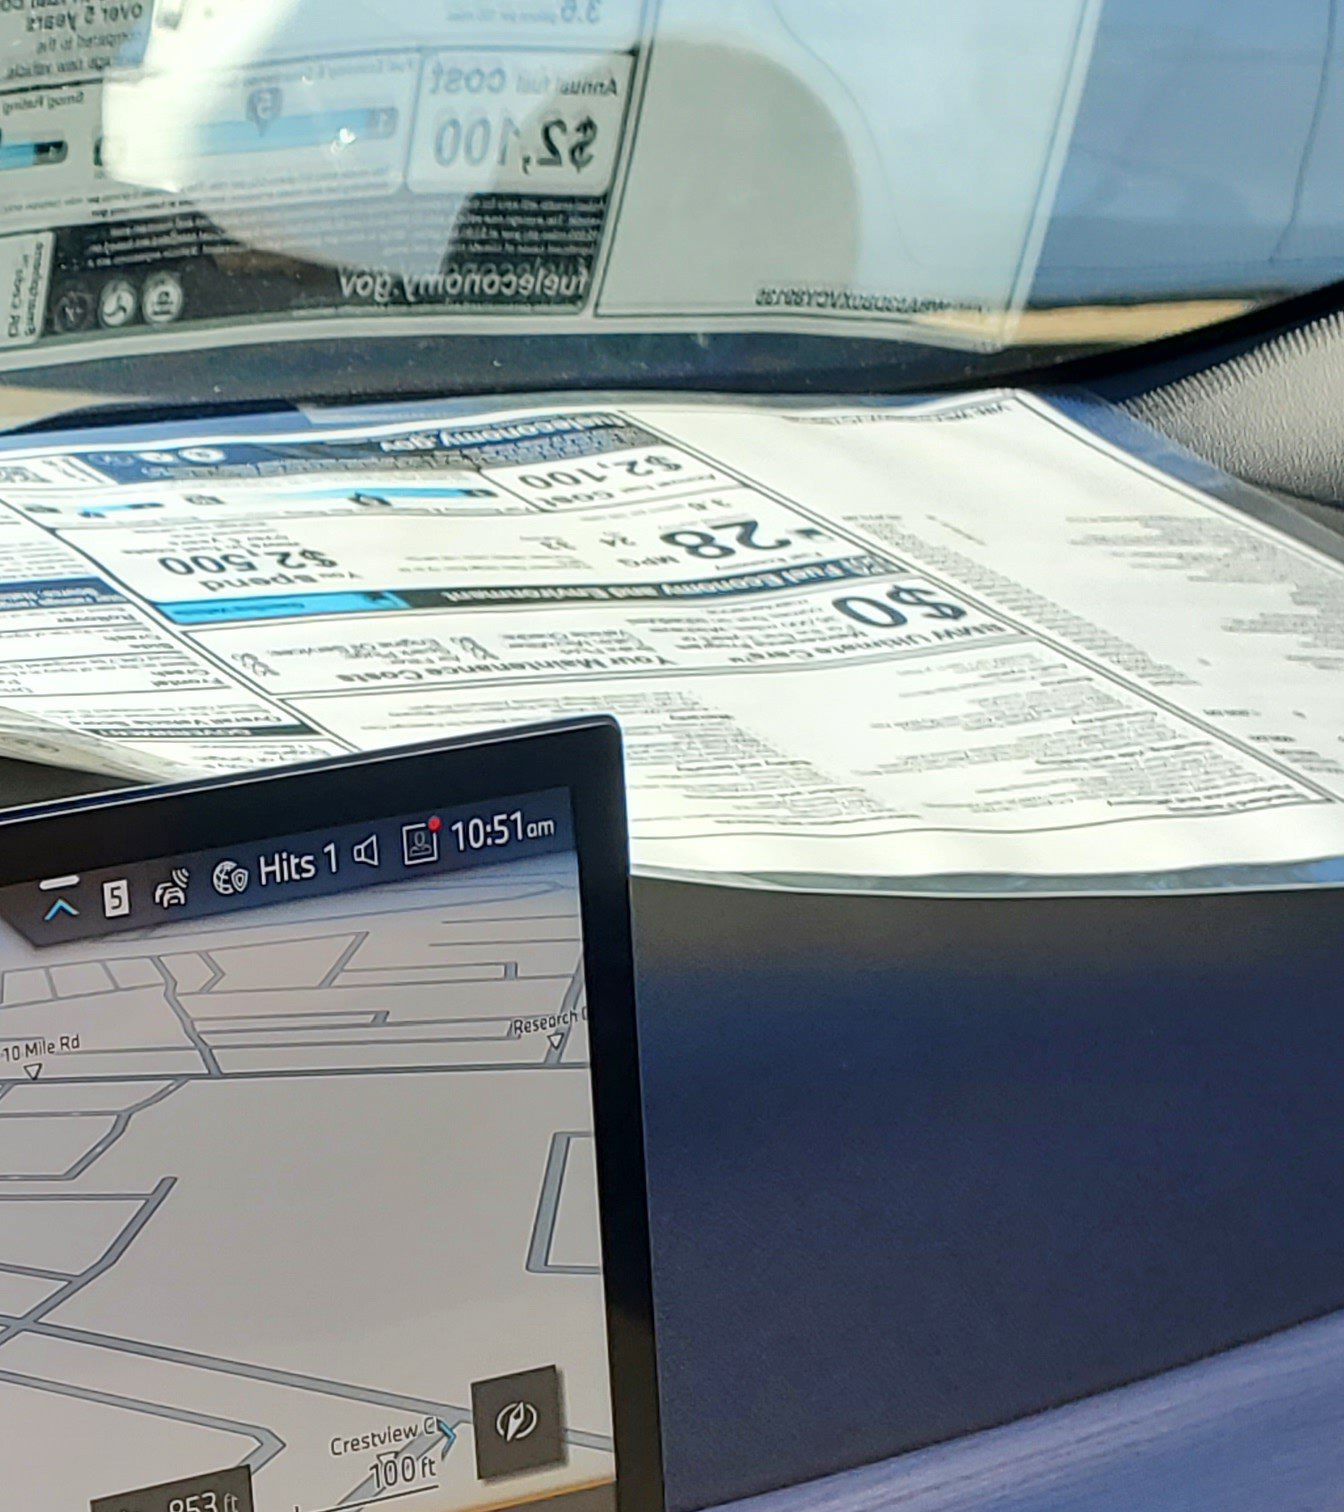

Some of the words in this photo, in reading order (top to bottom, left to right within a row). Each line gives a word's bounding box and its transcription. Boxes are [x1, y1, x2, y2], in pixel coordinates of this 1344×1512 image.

[380, 413, 629, 453] fueleconomy.gov
[518, 455, 683, 490] $2,100
[659, 519, 792, 561] 28
[157, 548, 339, 577] $2,500
[198, 573, 319, 593] spend
[441, 588, 611, 603] Environment
[613, 584, 658, 600] and
[661, 568, 785, 600] Economy
[831, 585, 968, 629] $0
[335, 670, 423, 684] Costs
[423, 657, 608, 677] Maintenance
[450, 810, 556, 855] 10:51am
[258, 851, 317, 886] Hits
[323, 844, 339, 874] 1
[513, 1009, 578, 1036] Research
[4, 1045, 21, 1063] 10
[23, 1037, 55, 1061] Mile
[59, 1033, 81, 1053] Rd
[330, 1423, 420, 1457] Crestview
[369, 1455, 417, 1490] 100
[420, 1454, 438, 1478] ft
